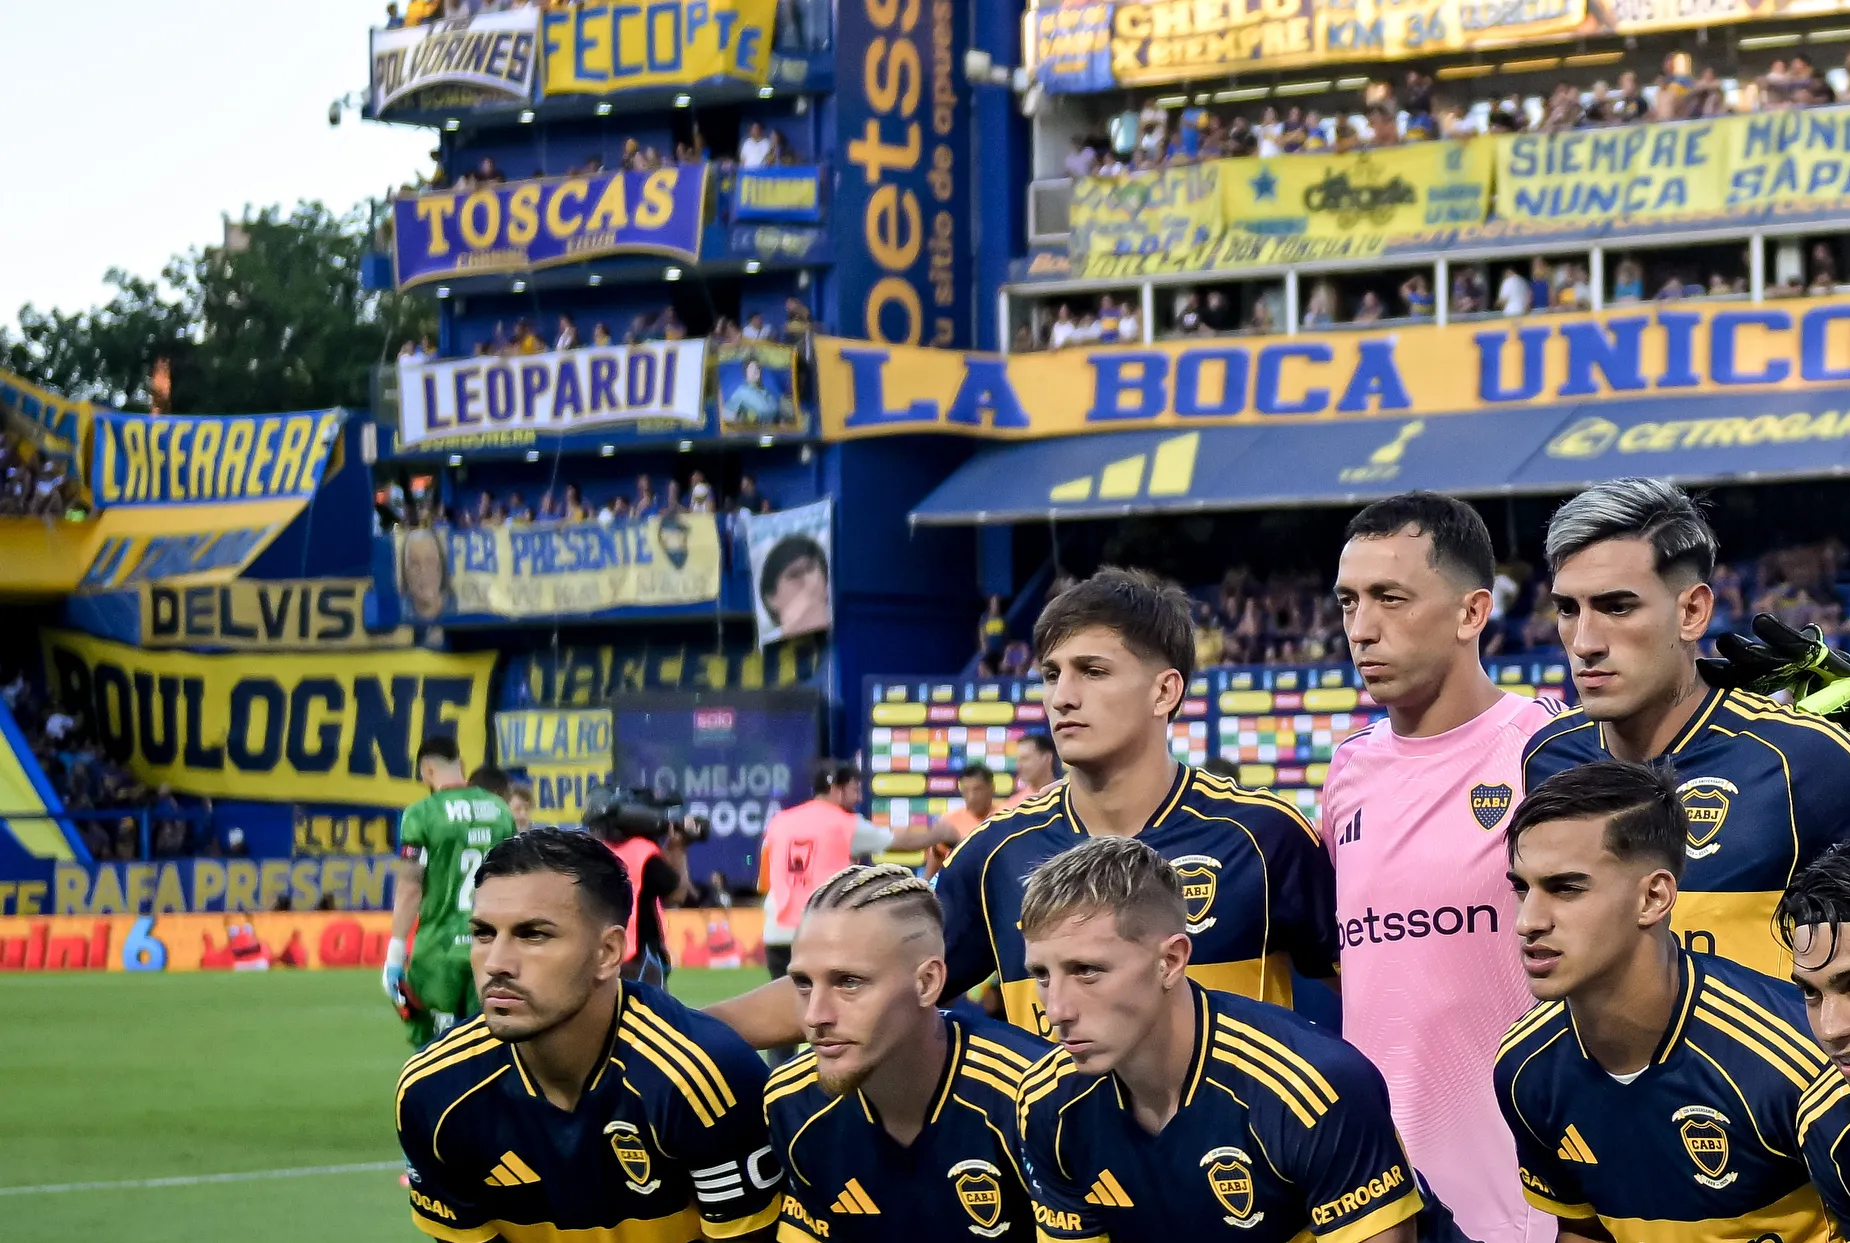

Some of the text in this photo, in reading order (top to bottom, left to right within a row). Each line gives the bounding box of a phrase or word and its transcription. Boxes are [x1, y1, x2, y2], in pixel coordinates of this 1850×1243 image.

[1508, 122, 1714, 178] SIEMPRE
[417, 168, 680, 256] TOSCAS
[1516, 175, 1688, 218] NUNCA
[423, 349, 680, 430] LEOPARDI
[838, 348, 1032, 431] LA
[1086, 337, 1412, 423] BOCA
[102, 414, 340, 502] LAFERRERE
[684, 764, 792, 798] MEJOR
[1471, 793, 1509, 810] CABJ
[1686, 809, 1719, 820] CABJ
[55, 860, 187, 915] RAFA
[1184, 886, 1209, 897] ABJ
[121, 914, 169, 972] 6
[1691, 1139, 1722, 1150] CABJ
[965, 1192, 996, 1203] CABJ
[1219, 1181, 1248, 1192] CABJ
[1310, 1164, 1405, 1227] CETROGAR
